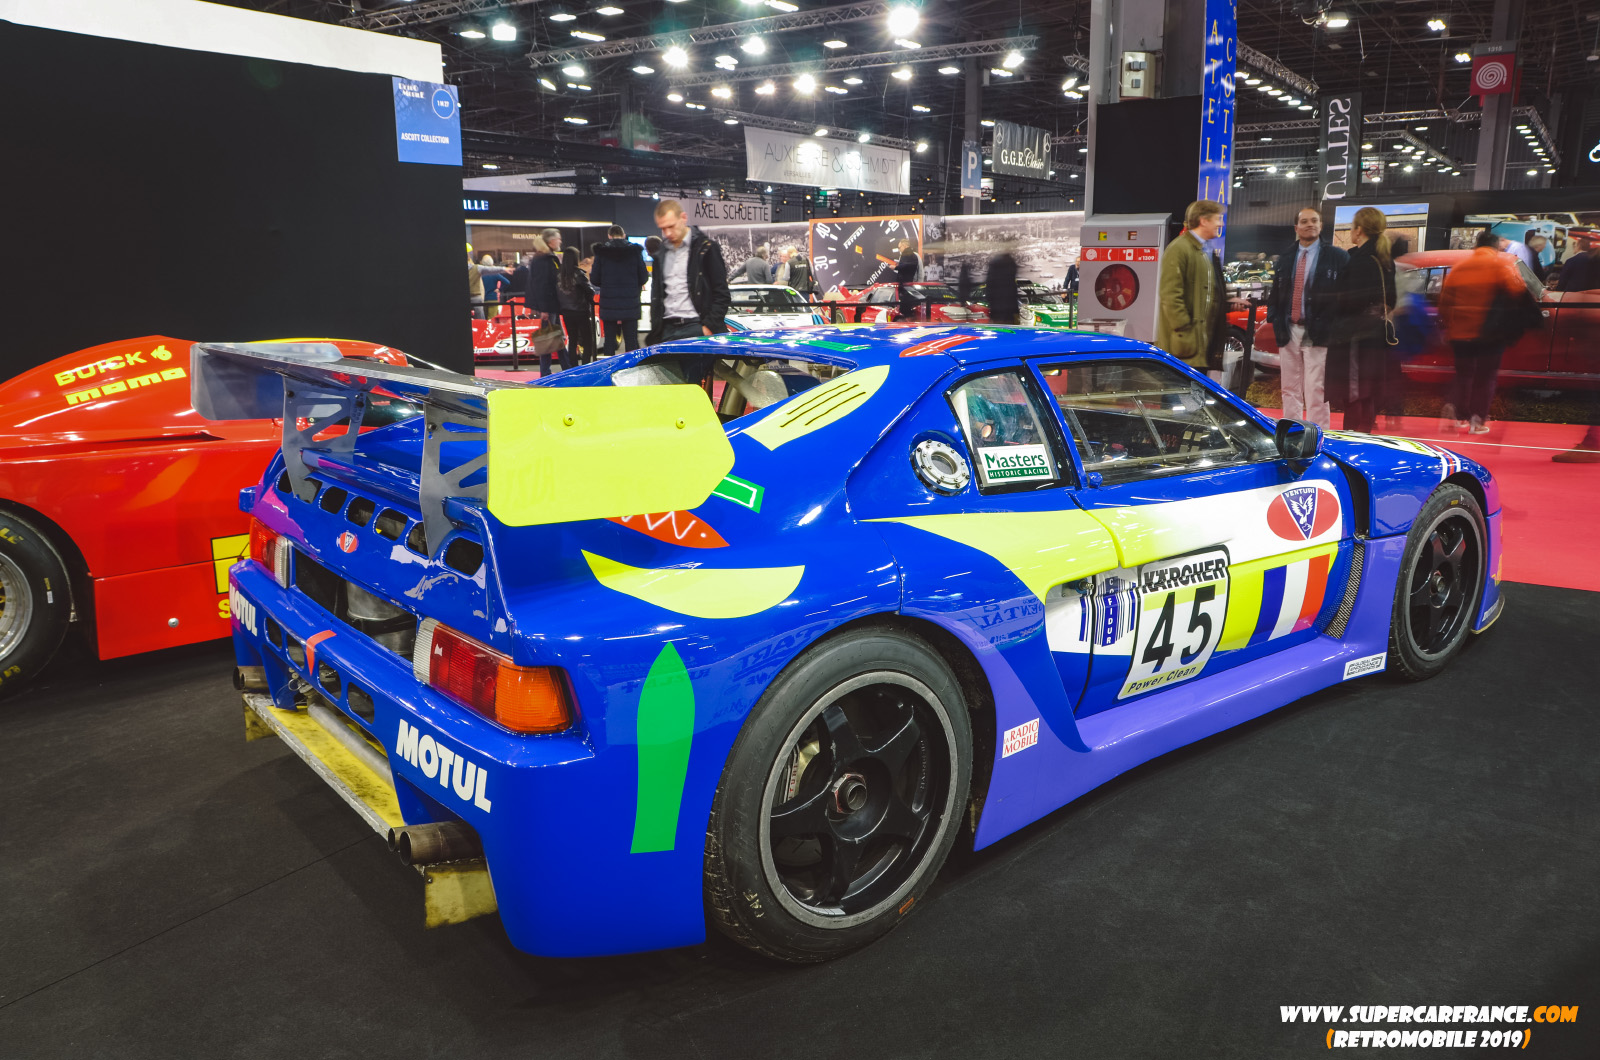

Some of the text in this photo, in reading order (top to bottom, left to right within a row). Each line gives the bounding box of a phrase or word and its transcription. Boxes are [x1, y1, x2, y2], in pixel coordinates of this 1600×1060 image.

[1205, 19, 1219, 201] ATELI
[401, 132, 449, 144] ASCOTT COLLECTION
[764, 142, 829, 167] AUXIERE
[832, 146, 844, 173] &
[967, 151, 977, 179] P
[1001, 149, 1025, 167] G.G.E.
[463, 199, 489, 210] ILLE
[694, 202, 769, 221] AXEL SCHUETTE
[816, 222, 831, 239] 40
[843, 225, 866, 250] Ferrari
[813, 255, 829, 271] 30
[54, 351, 147, 387] BUICK
[65, 367, 187, 405] momo
[984, 452, 1046, 469] Masters
[989, 467, 1048, 478] HISTORIC RACING
[1284, 487, 1315, 498] VENTURI
[229, 582, 258, 637] MOTUL
[1141, 584, 1217, 674] 45
[1127, 665, 1197, 693] Power Clean
[1004, 731, 1038, 756] MOBILE
[1010, 720, 1039, 742] RADIO
[396, 718, 492, 814] MOTUL
